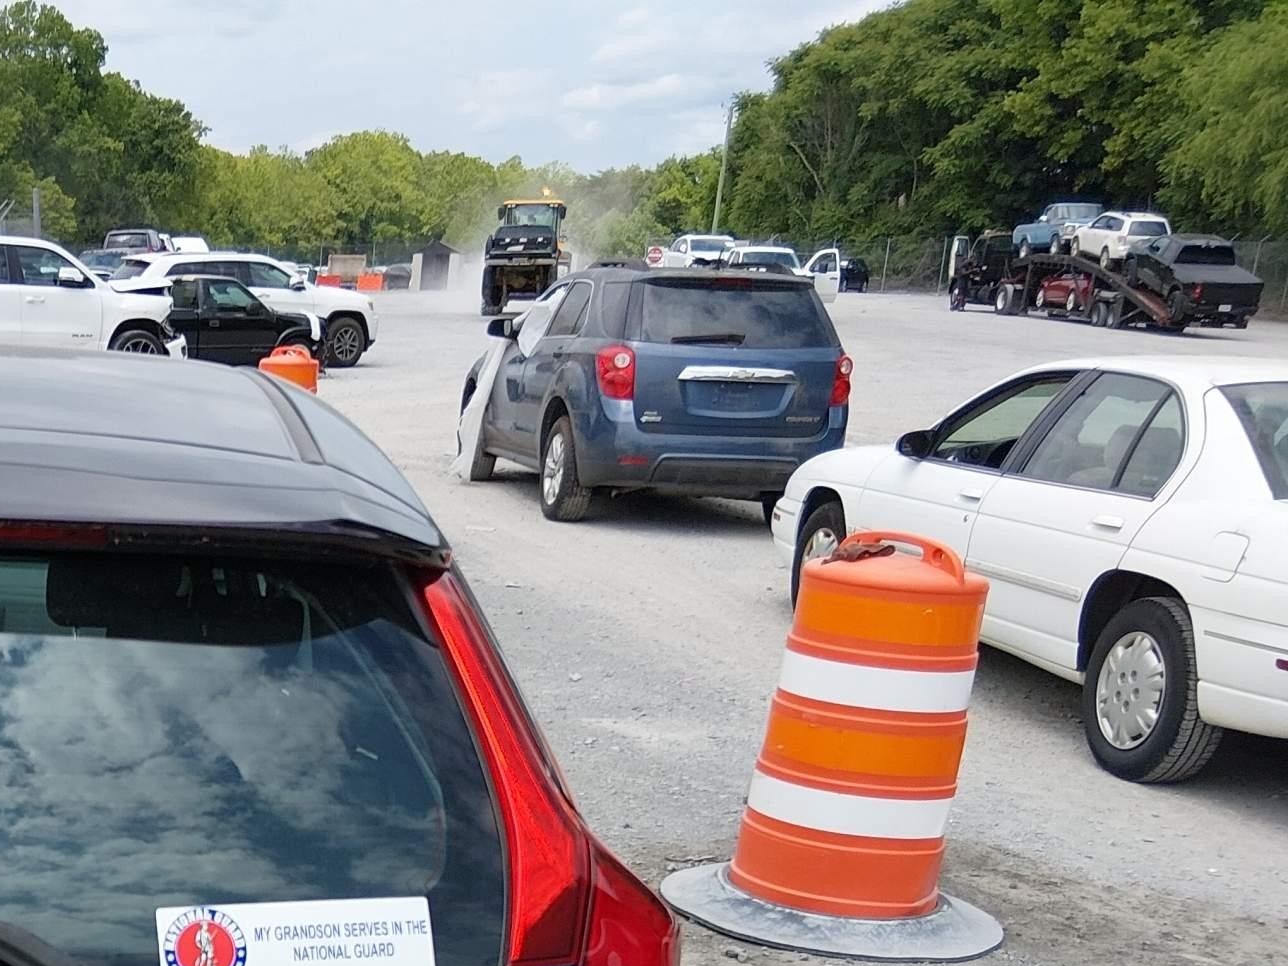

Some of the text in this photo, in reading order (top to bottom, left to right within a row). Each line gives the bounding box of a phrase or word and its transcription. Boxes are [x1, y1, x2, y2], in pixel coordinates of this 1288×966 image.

[164, 907, 246, 951] NATIONAL GUARD
[254, 919, 427, 942] MY GRANDSON SERVES IN THE
[293, 942, 395, 961] NATIONAL GUARD
